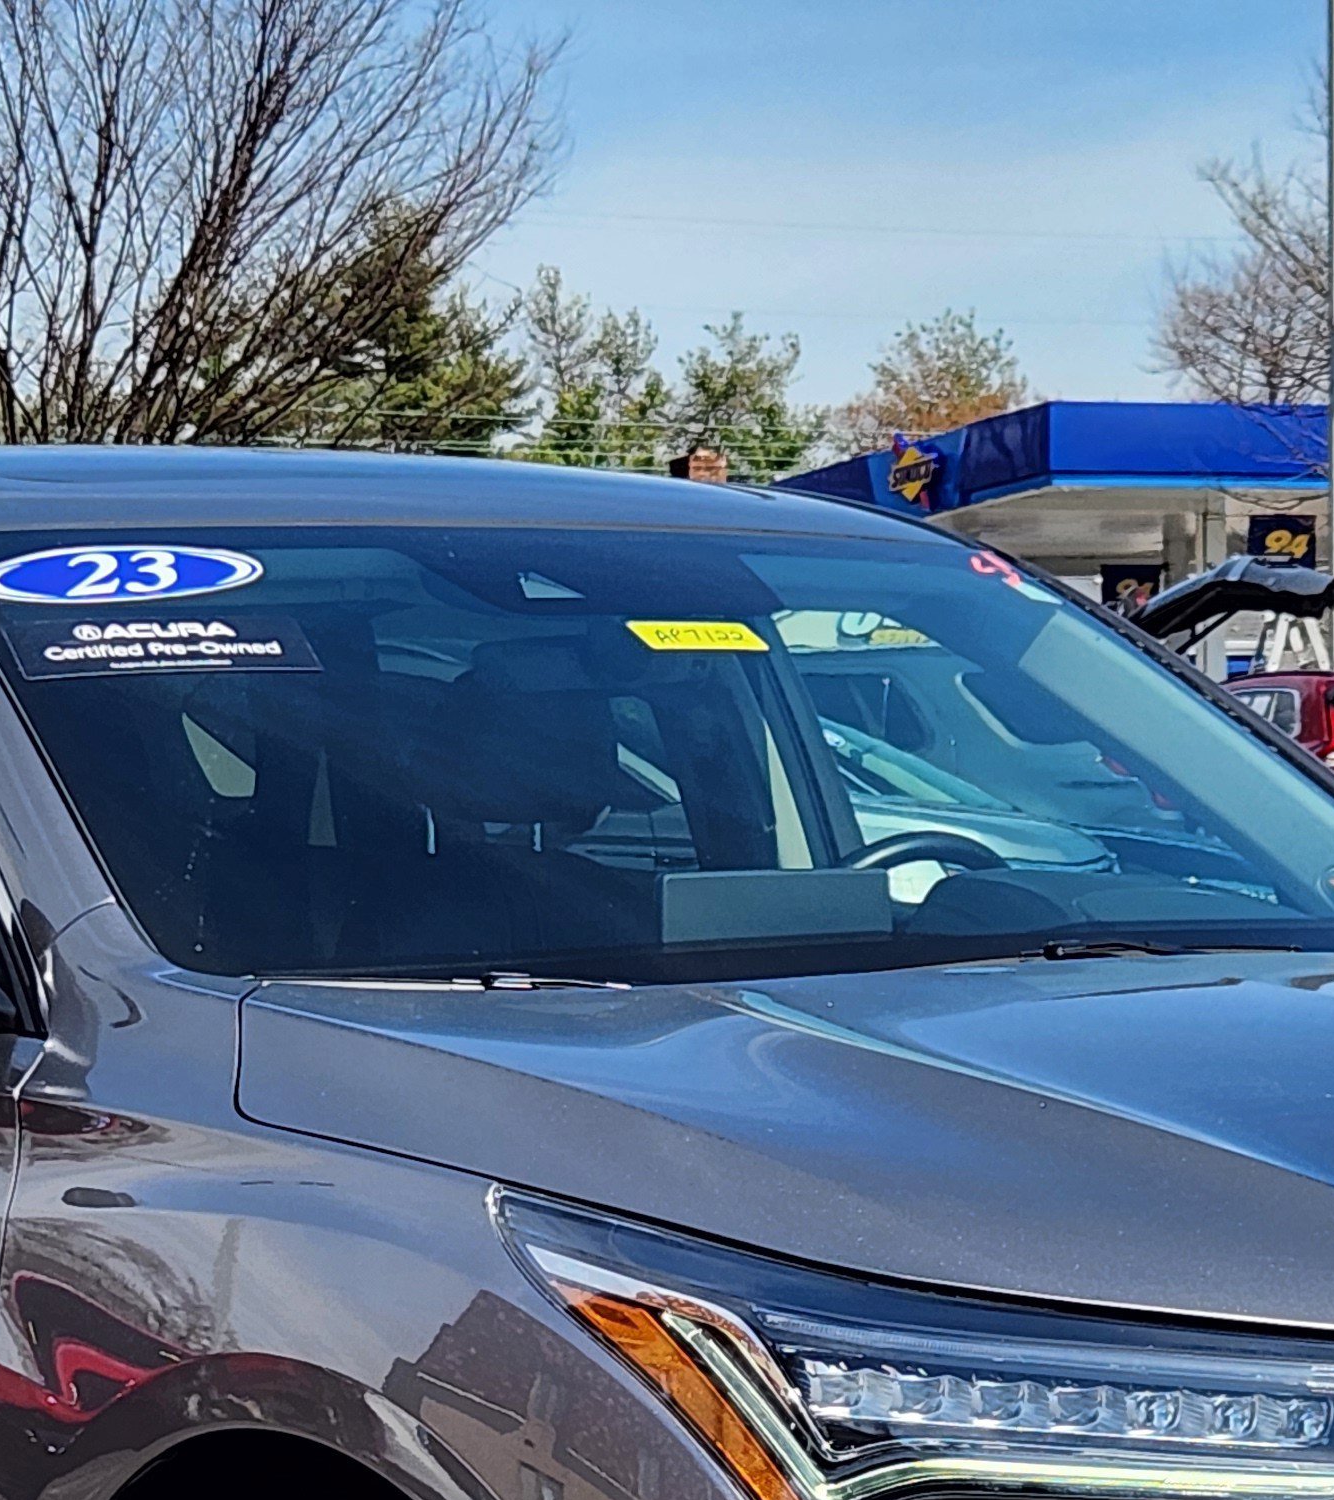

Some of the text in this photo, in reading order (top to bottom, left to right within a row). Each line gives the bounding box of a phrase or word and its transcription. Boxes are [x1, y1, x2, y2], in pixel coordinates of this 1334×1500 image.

[1265, 529, 1310, 558] 94
[66, 550, 179, 597] 23
[102, 621, 238, 640] ACURA
[43, 639, 282, 662] Certified Pre-Owned
